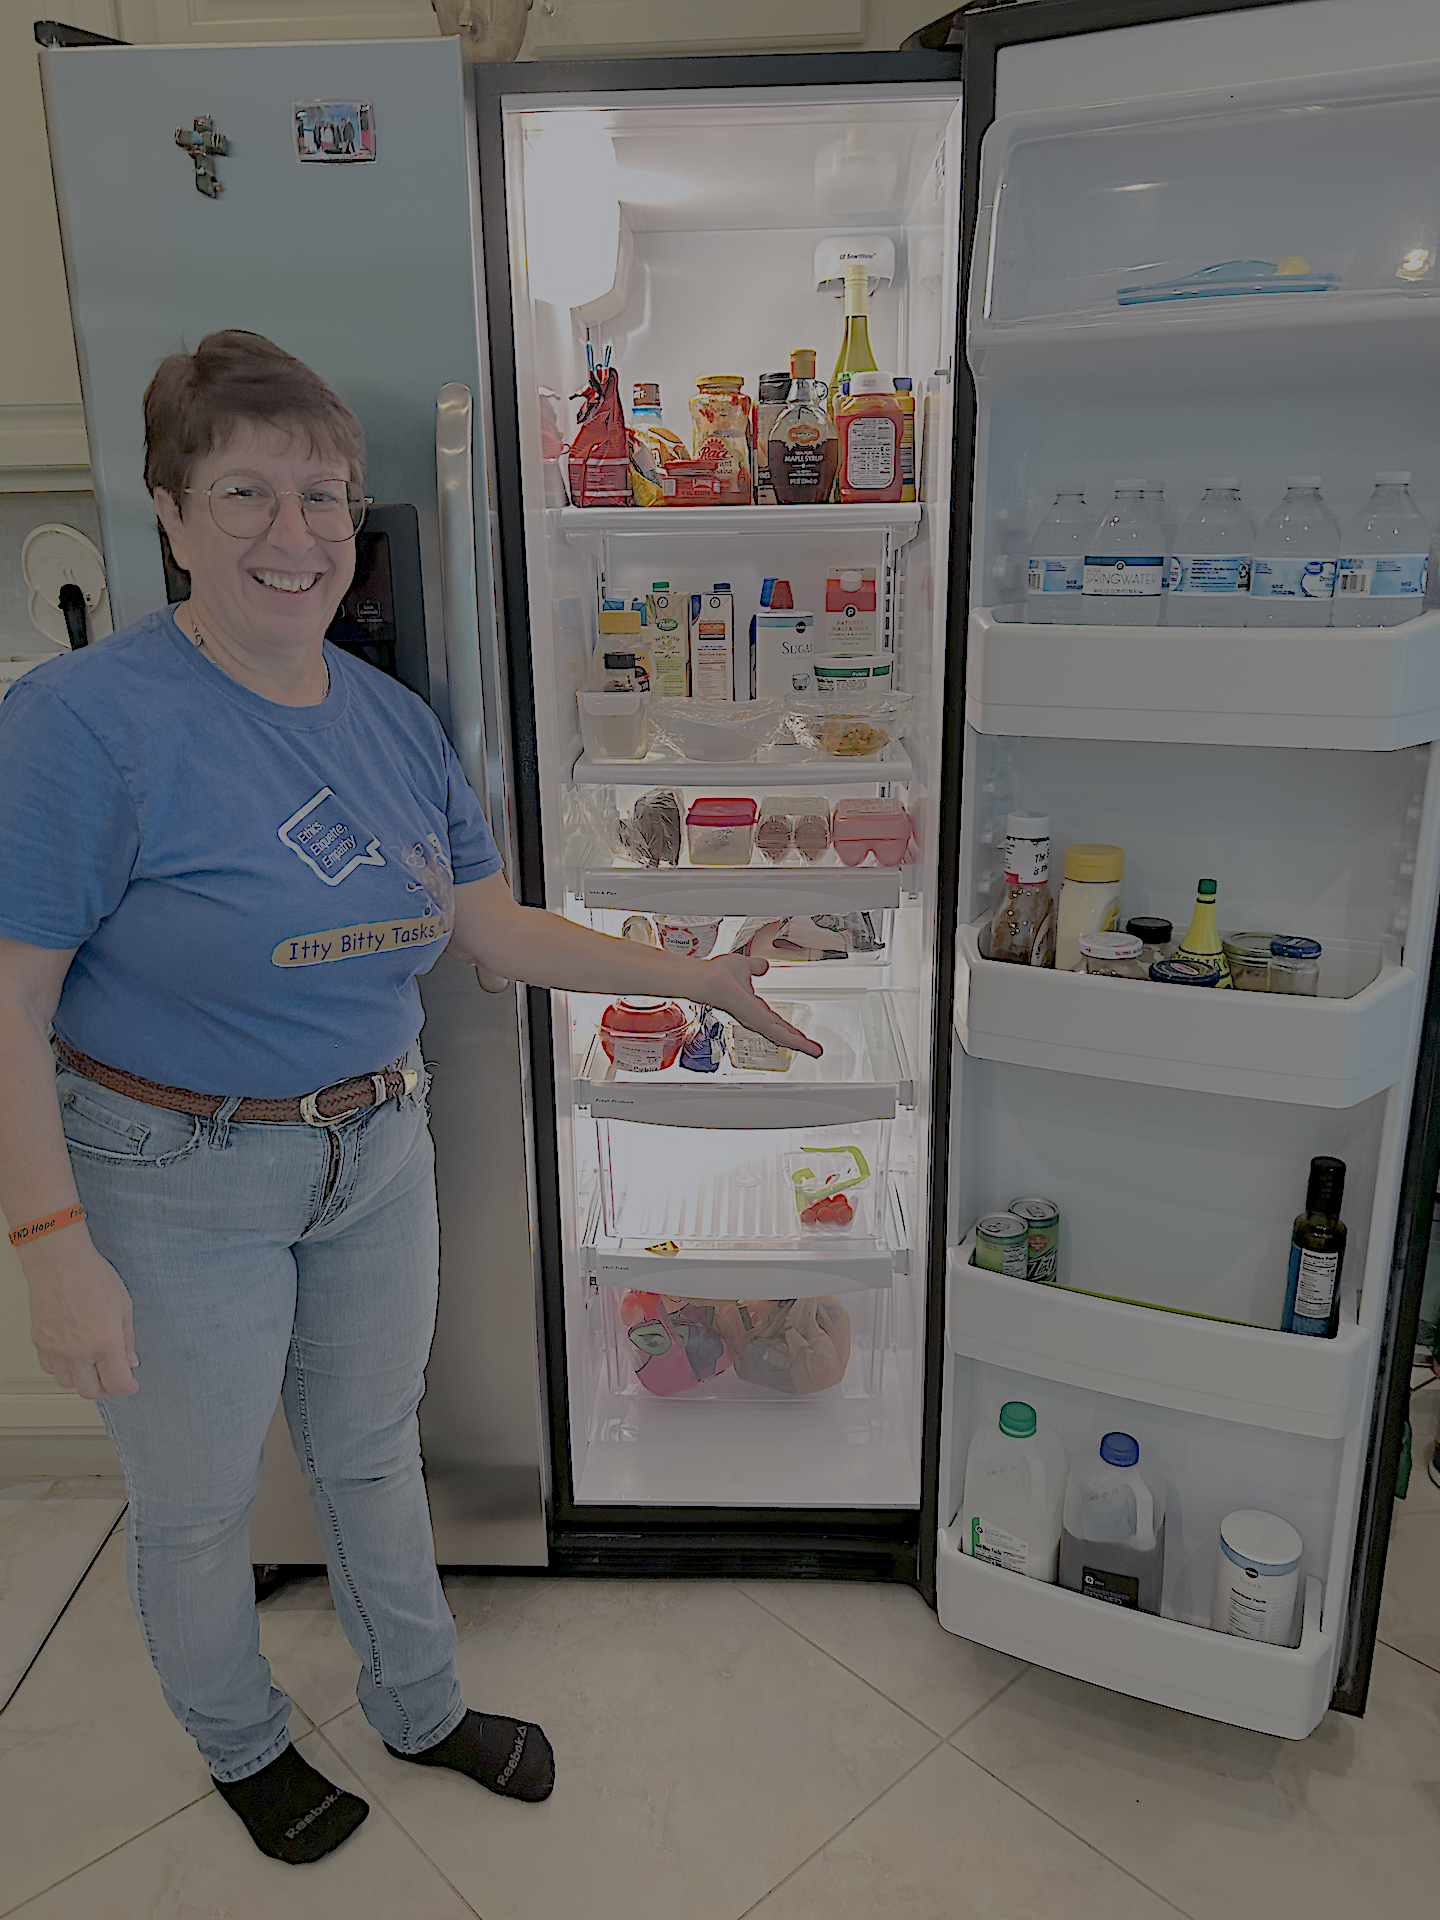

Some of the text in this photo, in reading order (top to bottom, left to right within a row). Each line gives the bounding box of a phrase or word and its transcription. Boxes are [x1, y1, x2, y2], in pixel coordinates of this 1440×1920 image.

[784, 455, 805, 463] MAPLE
[804, 453, 825, 463] SYRUP
[297, 820, 326, 845] Ethics,
[309, 822, 349, 857] Etiquette,
[321, 834, 358, 869] Empathy
[289, 939, 333, 961] Itty
[341, 931, 386, 954] Bitty
[32, 1219, 56, 1235] Hope
[496, 1736, 526, 1788] Reebok
[284, 1794, 339, 1841] Reebok
